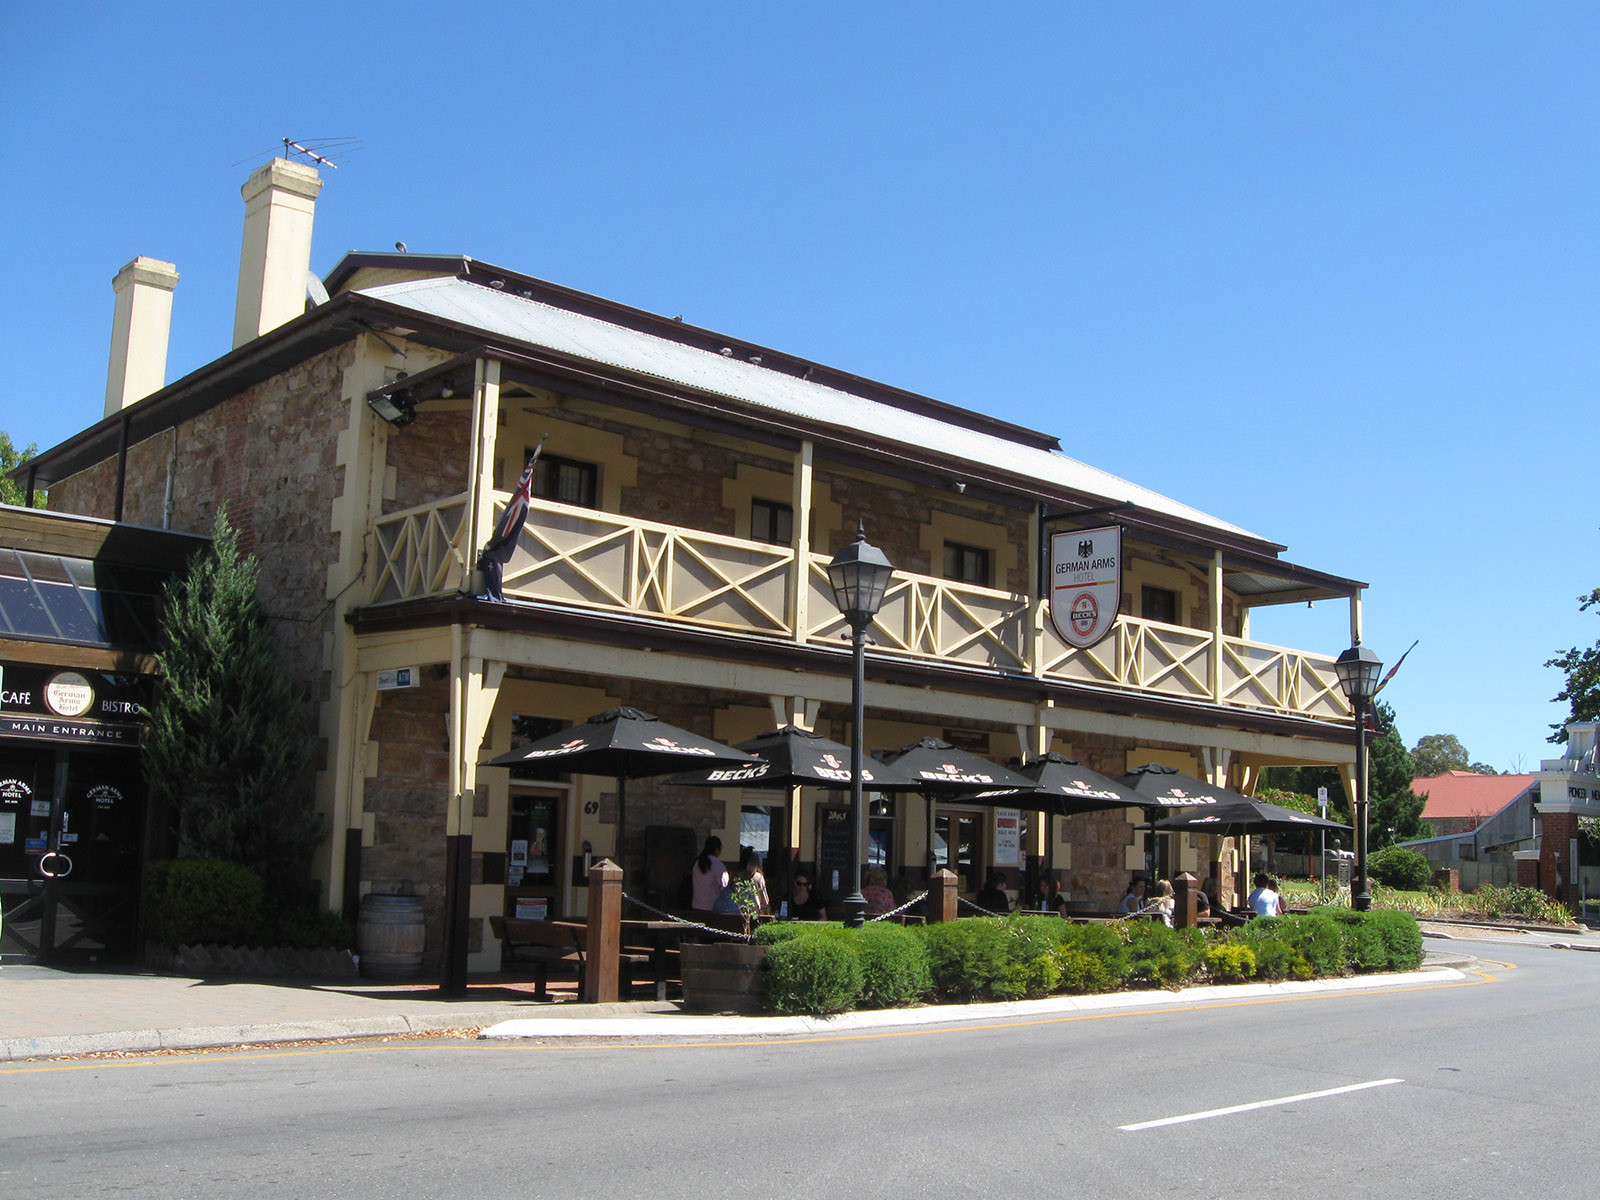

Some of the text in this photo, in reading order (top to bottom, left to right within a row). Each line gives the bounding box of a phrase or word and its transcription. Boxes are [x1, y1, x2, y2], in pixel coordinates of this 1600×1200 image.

[1055, 557, 1116, 574] GERMAN ARMS
[1074, 572, 1095, 583] HOTEL
[0, 690, 31, 705] CAFÉ
[102, 700, 140, 714] BISTRO
[12, 723, 122, 738] MAIN ENTRANCE
[707, 763, 771, 781] BECK'S
[813, 766, 875, 781] BECS
[919, 770, 994, 784] BECK'S
[1061, 786, 1121, 800] BECK'S
[1156, 795, 1218, 805] BECK'S
[584, 802, 599, 814] 69
